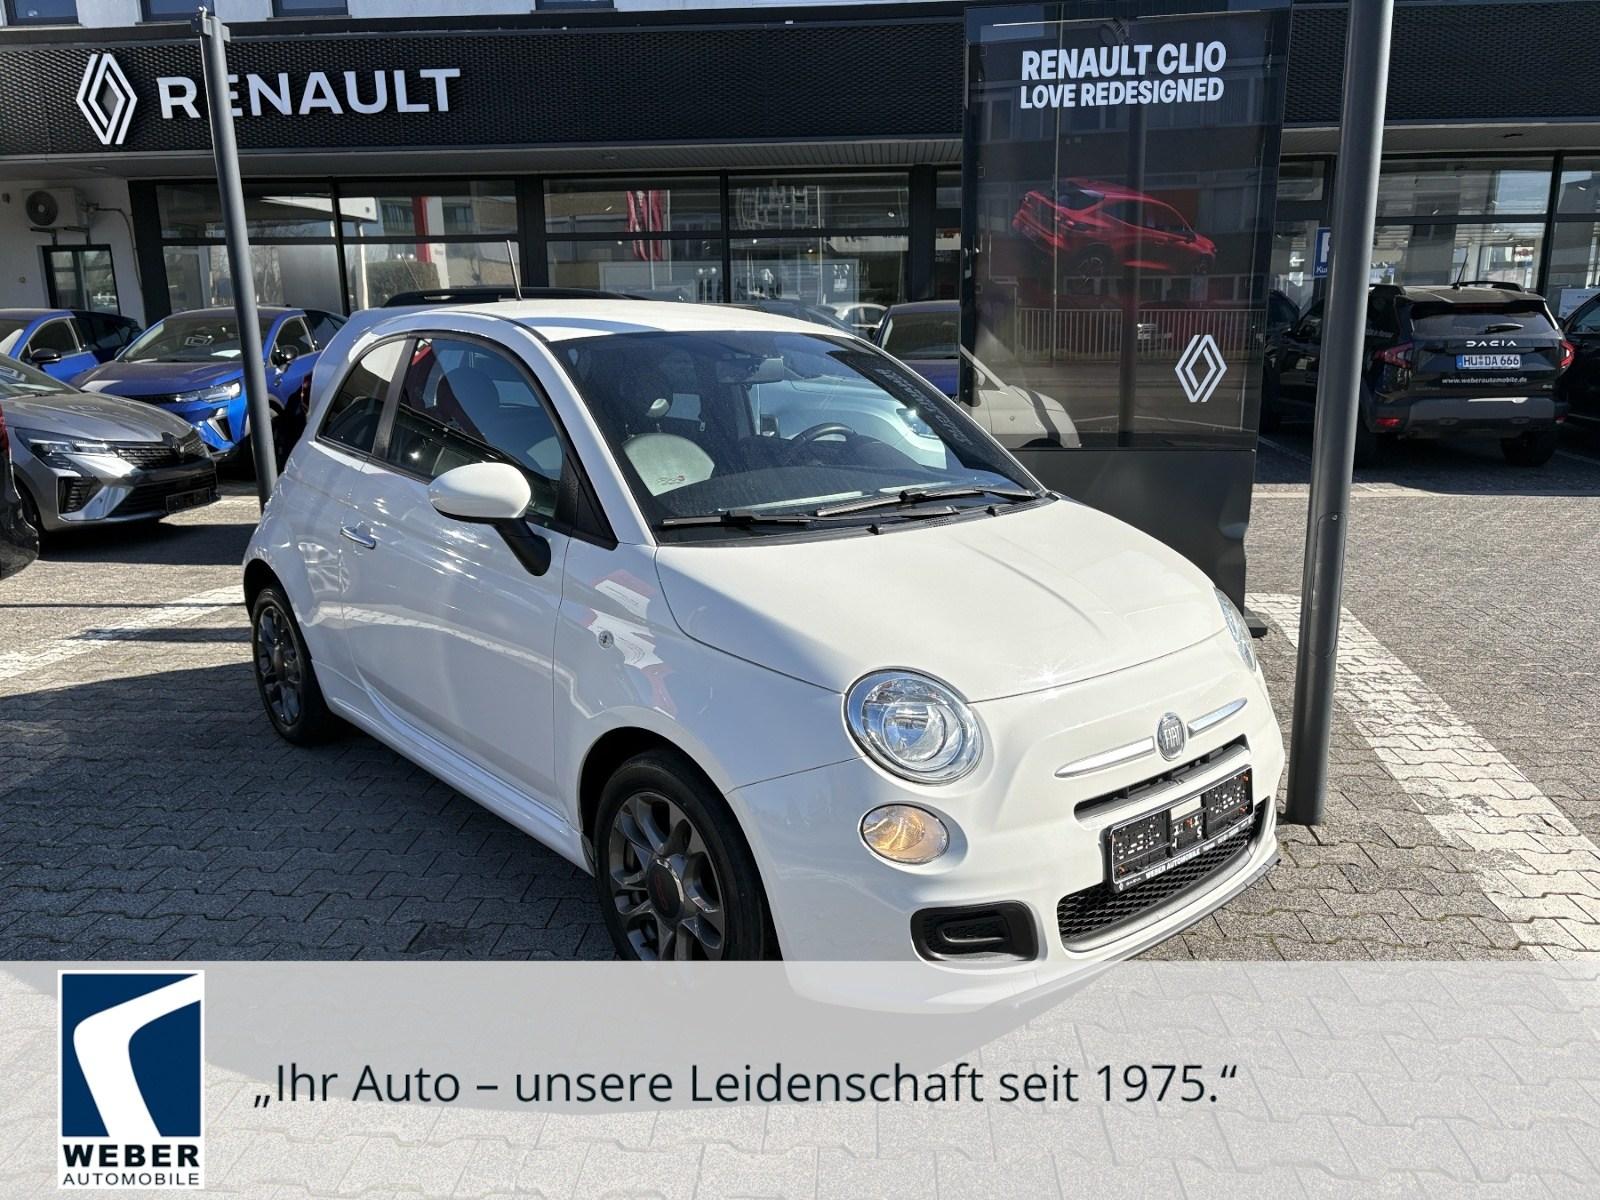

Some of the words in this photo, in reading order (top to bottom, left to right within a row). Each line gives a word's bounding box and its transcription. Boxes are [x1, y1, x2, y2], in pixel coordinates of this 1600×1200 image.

[1021, 45, 1153, 81] RENAULT
[1157, 41, 1227, 75] CLIO
[1020, 83, 1076, 109] LOVE
[1080, 77, 1225, 107] REDESIGNED
